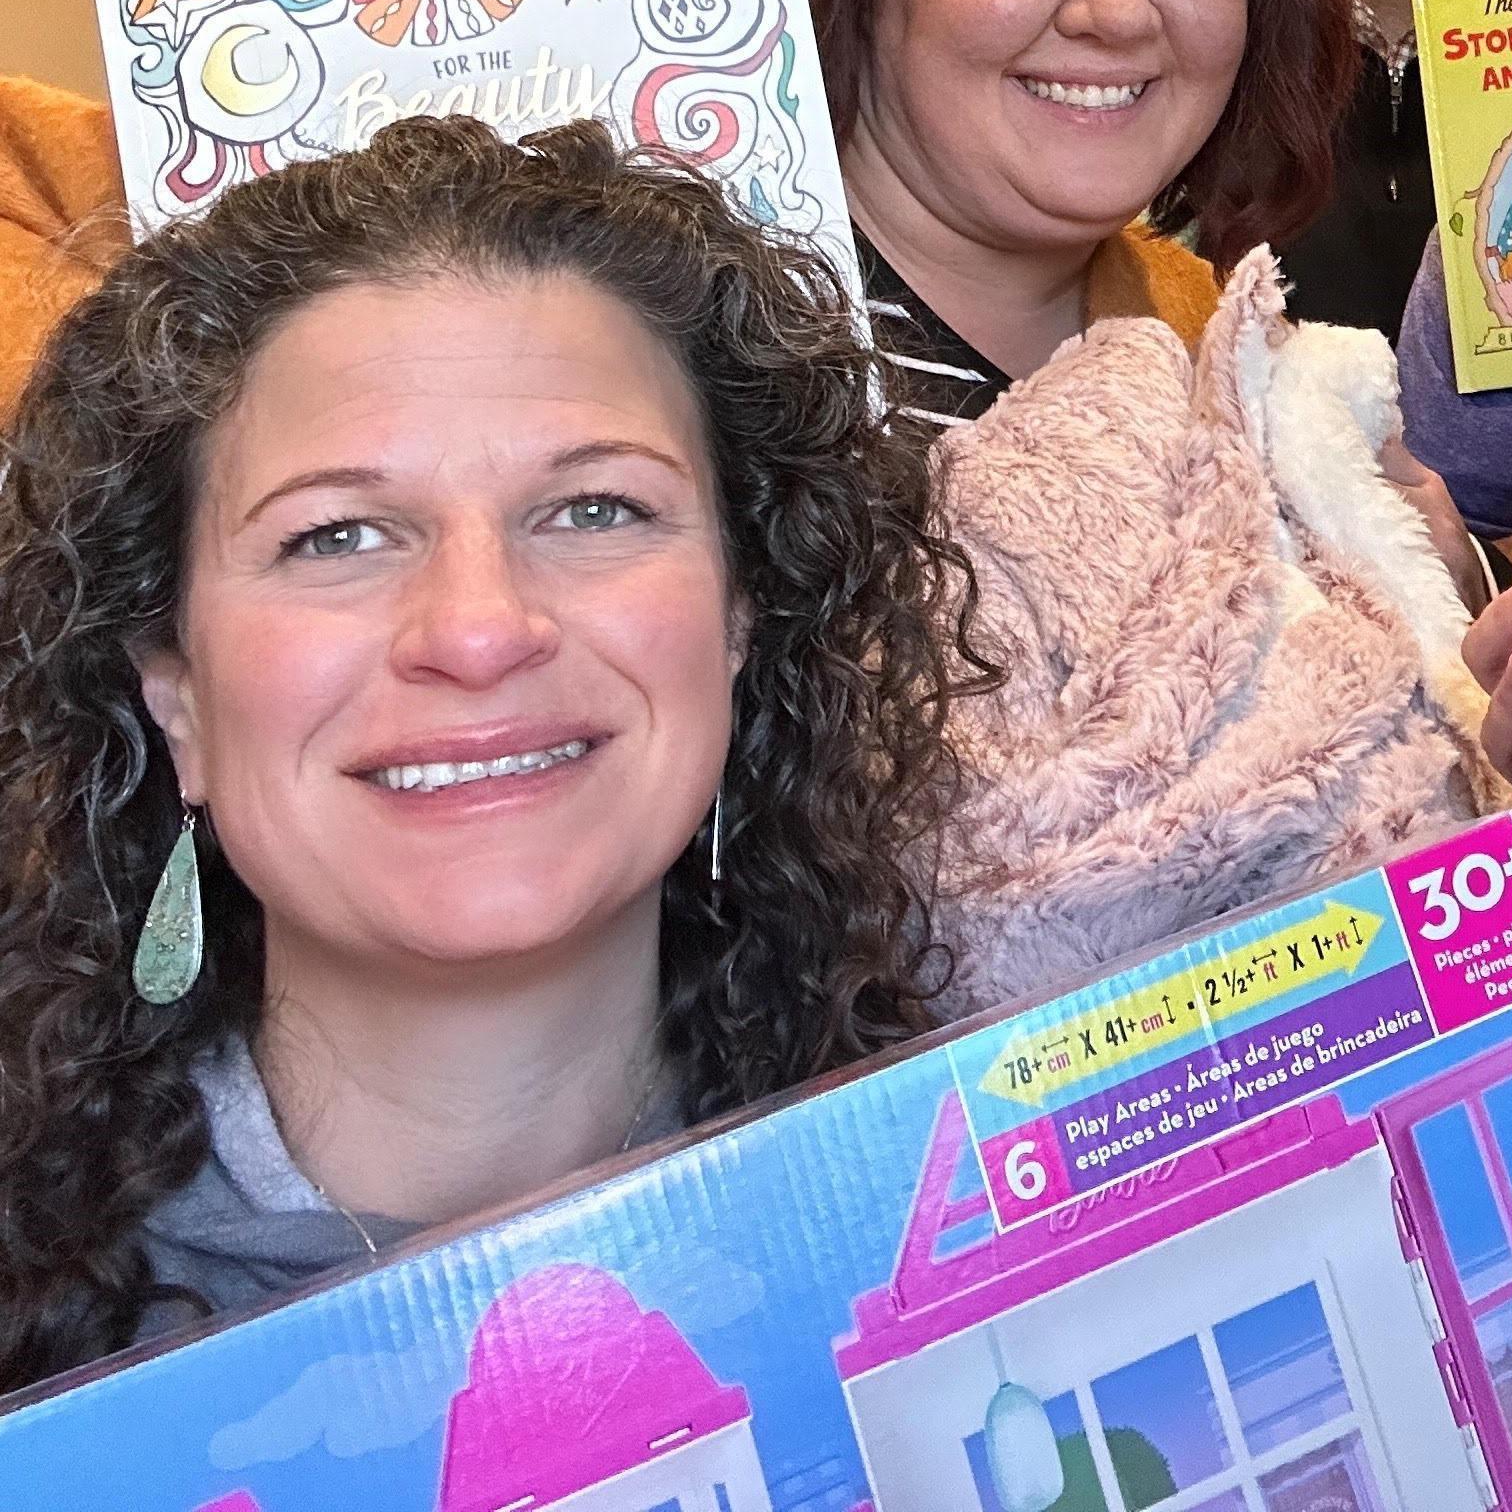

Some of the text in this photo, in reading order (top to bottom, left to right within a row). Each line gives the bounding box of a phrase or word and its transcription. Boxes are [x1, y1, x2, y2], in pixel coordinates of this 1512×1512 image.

[334, 45, 613, 152] Beauty
[432, 49, 513, 79] FOR THE
[1497, 329, 1507, 345] 8
[1433, 939, 1491, 971] Pieces
[1003, 1055, 1043, 1090] 78+
[1046, 1050, 1072, 1073] cm
[1079, 1029, 1098, 1060] X
[1104, 1015, 1138, 1047] 41+
[1139, 1011, 1165, 1035] cm
[1262, 959, 1279, 983] ft
[1287, 942, 1306, 972] X
[1311, 934, 1334, 961] 1+
[1335, 929, 1352, 952] ft
[1065, 1020, 1326, 1144] Play Areas Áreas de juego
[1075, 1125, 1156, 1171] espaces
[1158, 1106, 1184, 1133] de
[1185, 1096, 1220, 1130] jeu
[1290, 1049, 1315, 1076] de
[1316, 1006, 1424, 1068] brincadeira
[1004, 1140, 1047, 1201] 6
